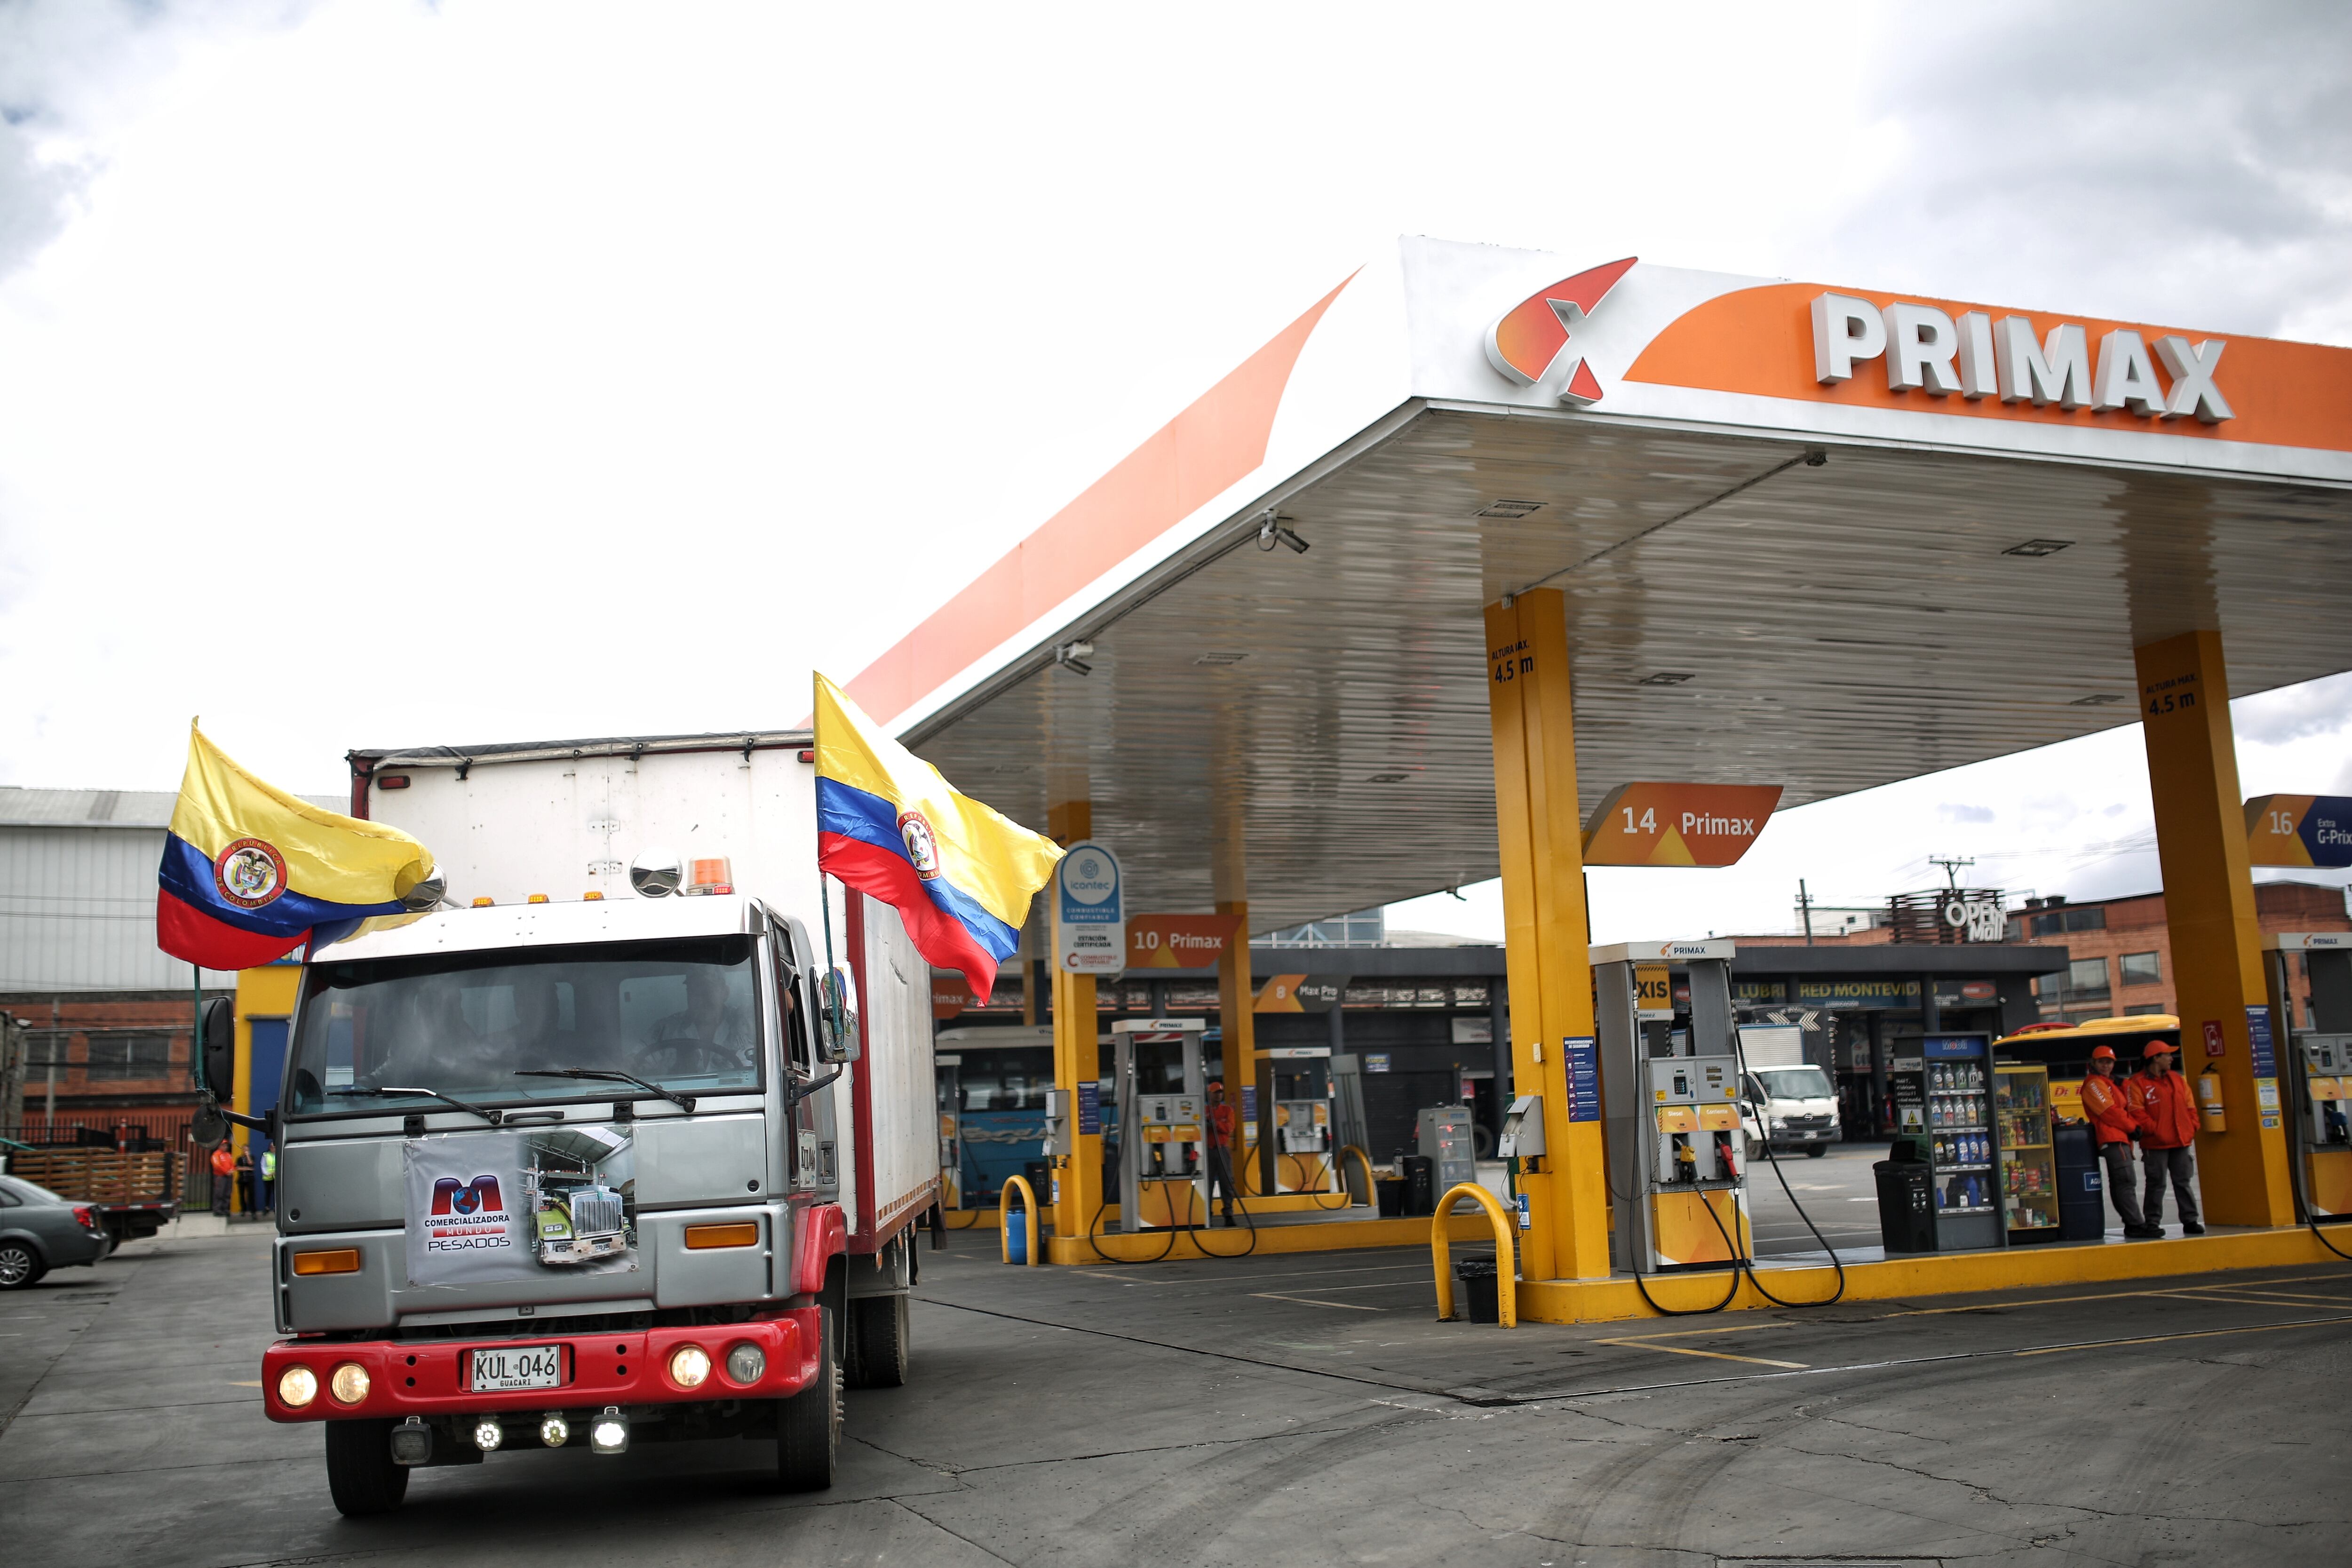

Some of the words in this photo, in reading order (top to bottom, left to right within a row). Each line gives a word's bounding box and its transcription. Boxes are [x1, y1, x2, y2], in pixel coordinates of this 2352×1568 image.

[1812, 290, 2236, 424] PRIMAX
[1492, 645, 1514, 661] ALTURA
[1495, 660, 1514, 683] 4.5
[1521, 656, 1533, 674] m
[2146, 679, 2176, 694] ALTURA
[2149, 694, 2175, 716] 4.5
[2180, 692, 2195, 708] m
[1622, 806, 1657, 834] 14
[1682, 812, 1755, 836] Primax
[2270, 811, 2293, 836] 16
[2317, 818, 2336, 828] Extra
[903, 813, 936, 847] REPUBLICA
[2317, 829, 2352, 845] G-Prix
[231, 840, 281, 865] REPUBLICA
[216, 876, 223, 888] DE
[224, 892, 274, 906] COLOMBIA
[1070, 881, 1109, 890] icontec
[1946, 901, 2008, 928] OPEN
[1135, 931, 1159, 949] 10
[1170, 933, 1222, 949] Primax
[1969, 923, 2003, 941] Mall
[1674, 946, 1706, 955] PRIMAX
[932, 992, 963, 1004] rimax
[1276, 986, 1286, 999] 8
[1299, 986, 1320, 996] Max
[1321, 985, 1338, 996] Pro
[1637, 980, 1668, 999] XIS
[1800, 983, 1831, 998] RED
[1835, 981, 1938, 997] MONTEVID
[1942, 1039, 1968, 1051] Mobil
[424, 1214, 510, 1227] COMERCIALIZADORA
[446, 1226, 492, 1236] MUNDO
[428, 1236, 511, 1252] PESADOS
[476, 1356, 513, 1380] KUL
[519, 1353, 556, 1377] 046
[500, 1378, 531, 1387] GUACARI
